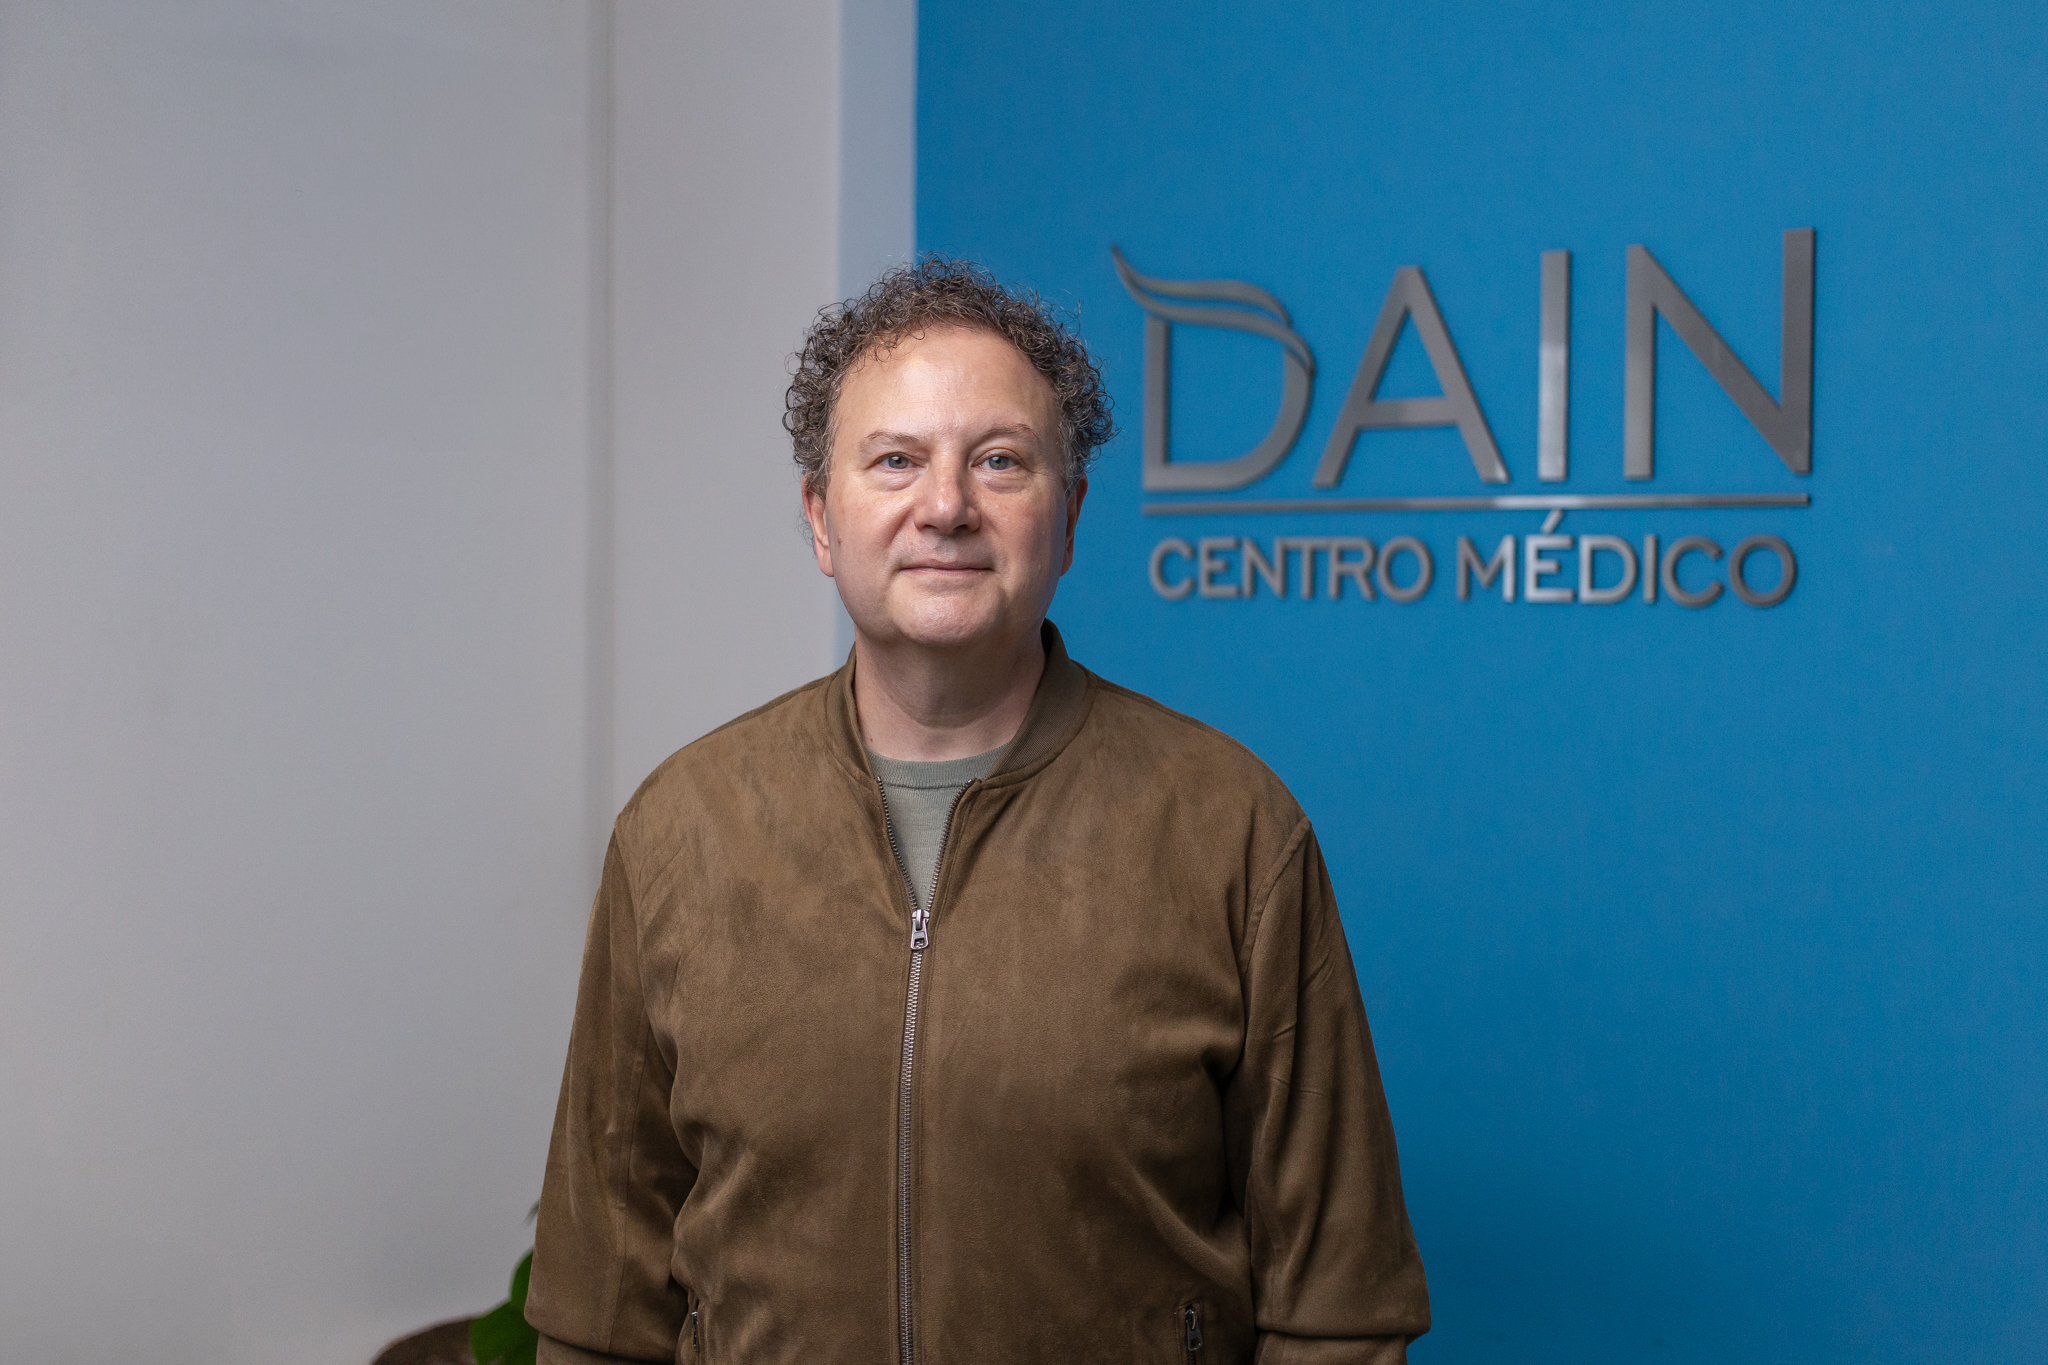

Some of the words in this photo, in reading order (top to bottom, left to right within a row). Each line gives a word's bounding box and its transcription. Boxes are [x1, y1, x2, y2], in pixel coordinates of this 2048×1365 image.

[1110, 227, 1816, 492] DAIN
[1148, 536, 1433, 602] CENTRO
[1456, 509, 1797, 608] MÉDICO
